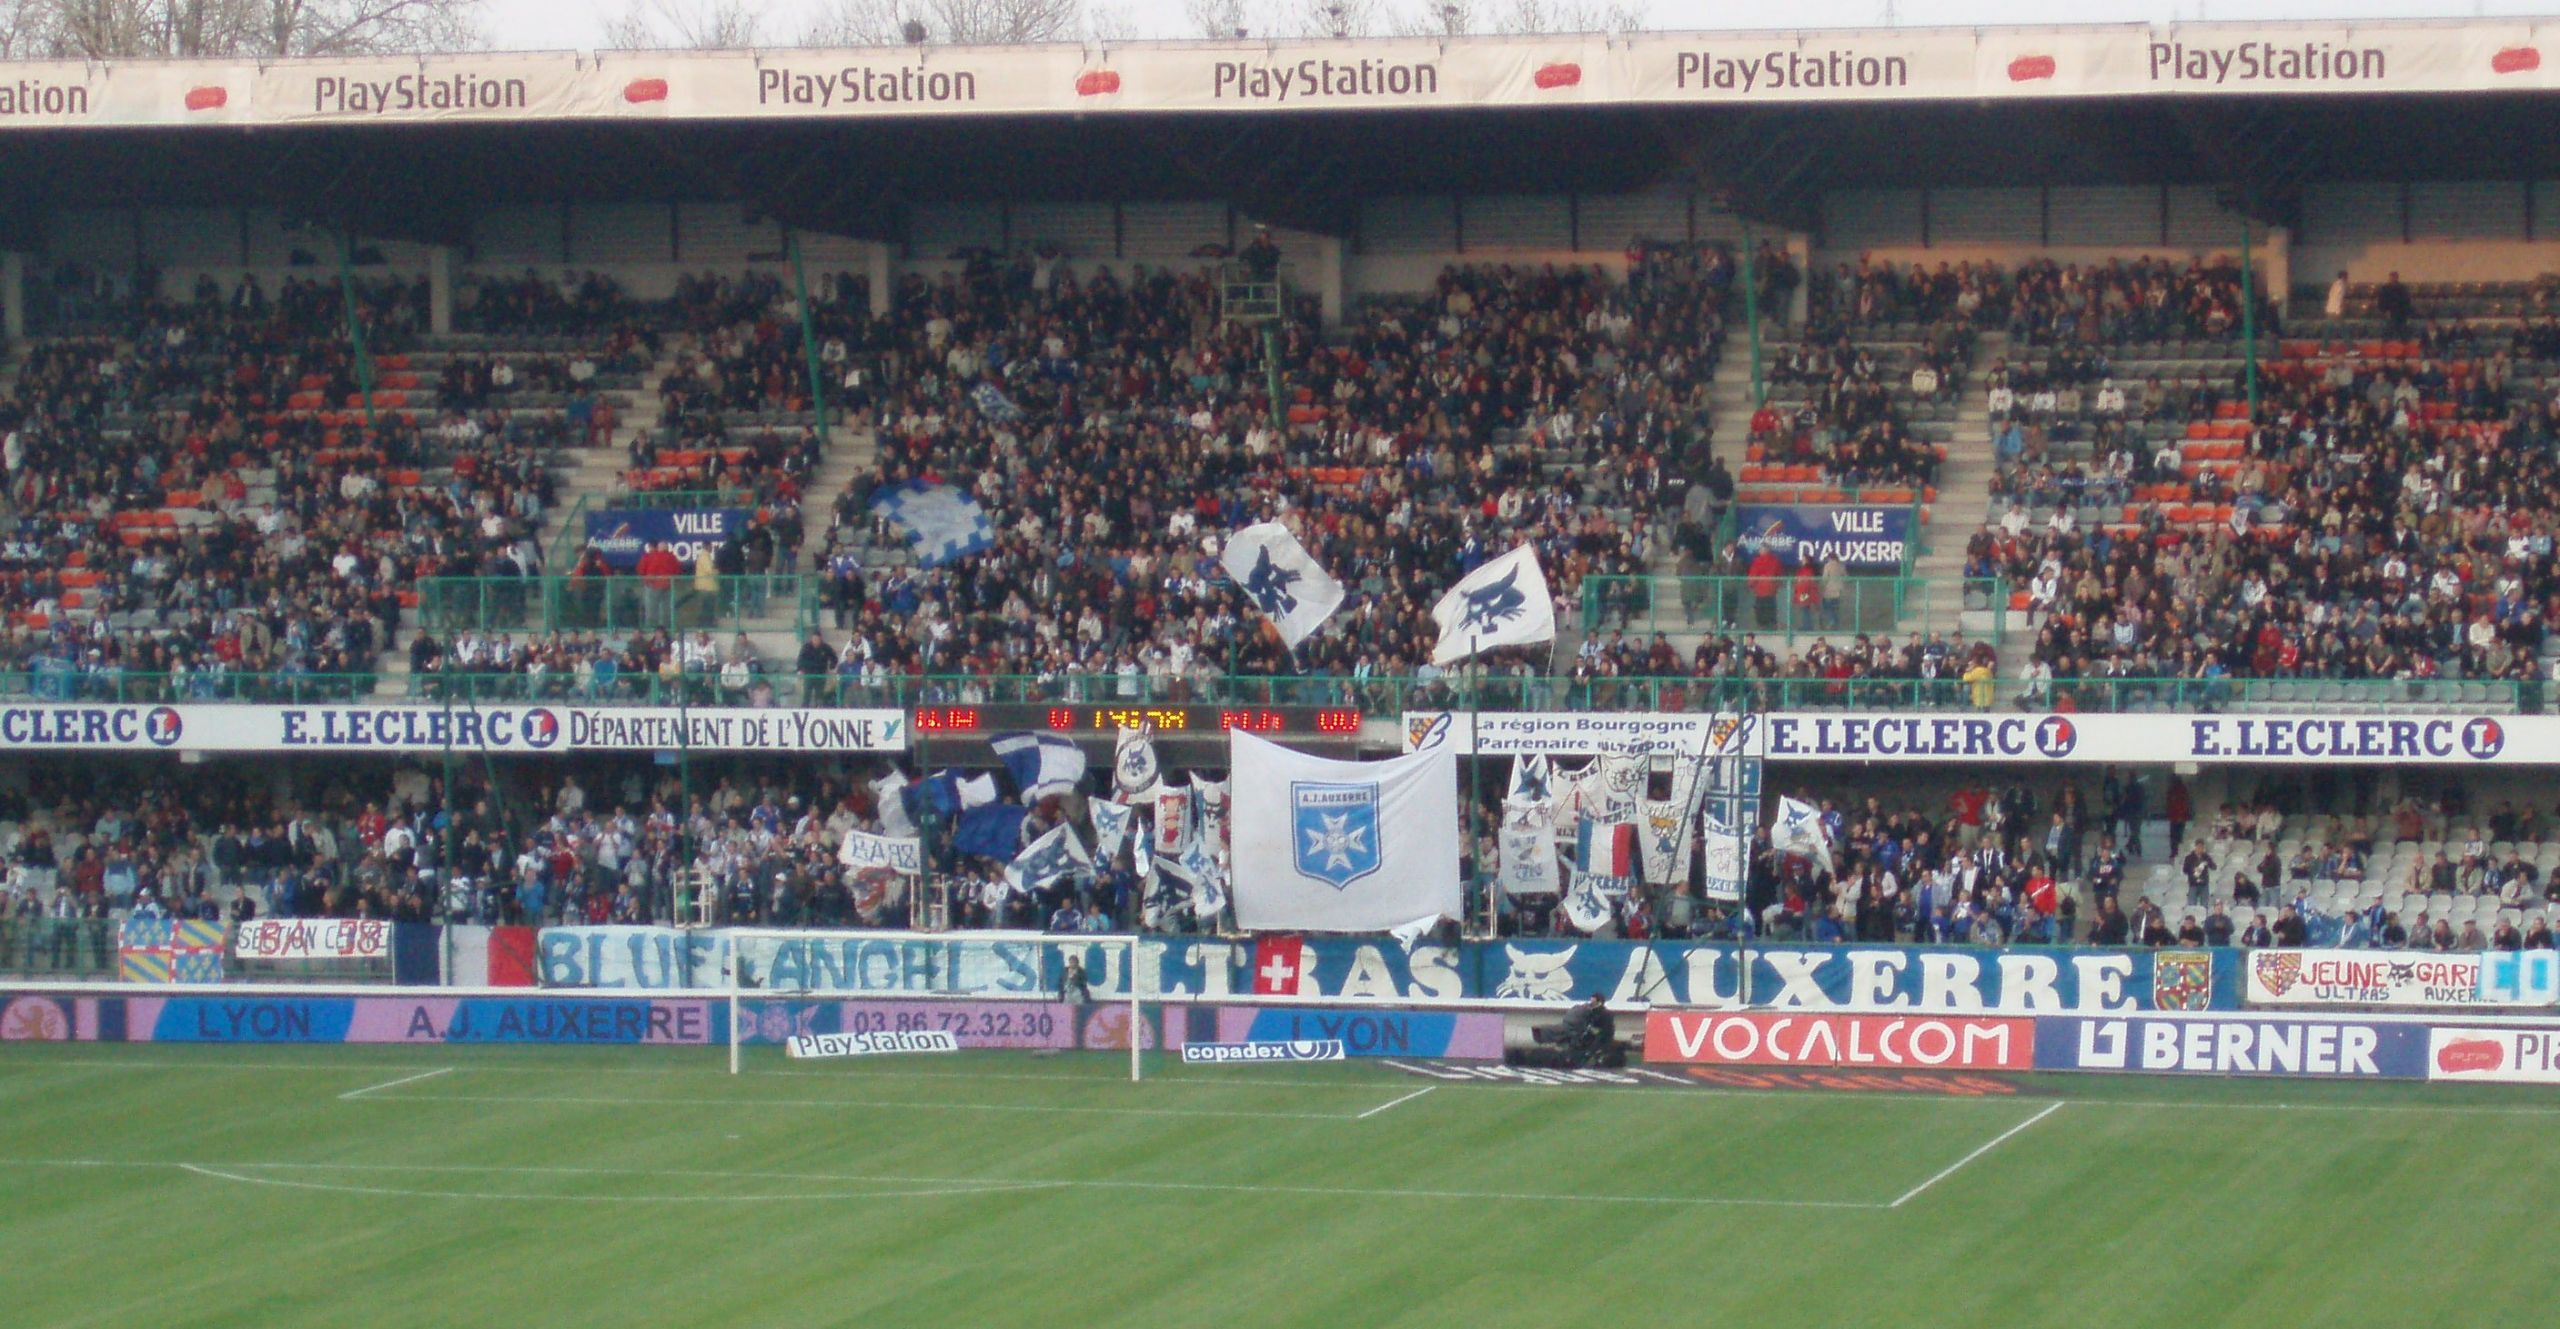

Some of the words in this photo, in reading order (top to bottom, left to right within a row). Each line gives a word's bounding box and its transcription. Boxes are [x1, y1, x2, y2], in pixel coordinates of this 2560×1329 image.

[1213, 58, 1438, 102] PlayStation
[1677, 51, 1907, 93] PlayStation
[2149, 42, 2386, 84] PlayStation
[0, 80, 87, 114] ation
[315, 73, 527, 114] PlayStation
[758, 67, 976, 109] PlayStation
[673, 513, 722, 534] VILLE
[1832, 511, 1883, 533] VILLE
[1798, 540, 1906, 562] D'AUXERR
[2, 708, 138, 743] CLERC
[281, 709, 513, 745] E.LECLERC
[1501, 717, 1570, 734] région
[1576, 718, 1697, 734] Bourgogne
[1770, 718, 2026, 755] E.LECLERC
[2191, 719, 2453, 756] E.LECLERC
[1478, 737, 1589, 751] Partenaire
[1606, 946, 2138, 1012] AUXERRE
[2302, 960, 2388, 988] JEUNE
[2314, 987, 2390, 1000] ULTRAS
[199, 1008, 310, 1037] LYON
[500, 1006, 701, 1040] AUXERRE
[1293, 1014, 1410, 1052] LYON
[799, 1031, 950, 1056] PlayStation
[1187, 1043, 1285, 1060] copadex
[1670, 1017, 2010, 1066] VOCALCOM
[2142, 1022, 2379, 1073] BERNER
[2515, 1033, 2560, 1071] Pl
